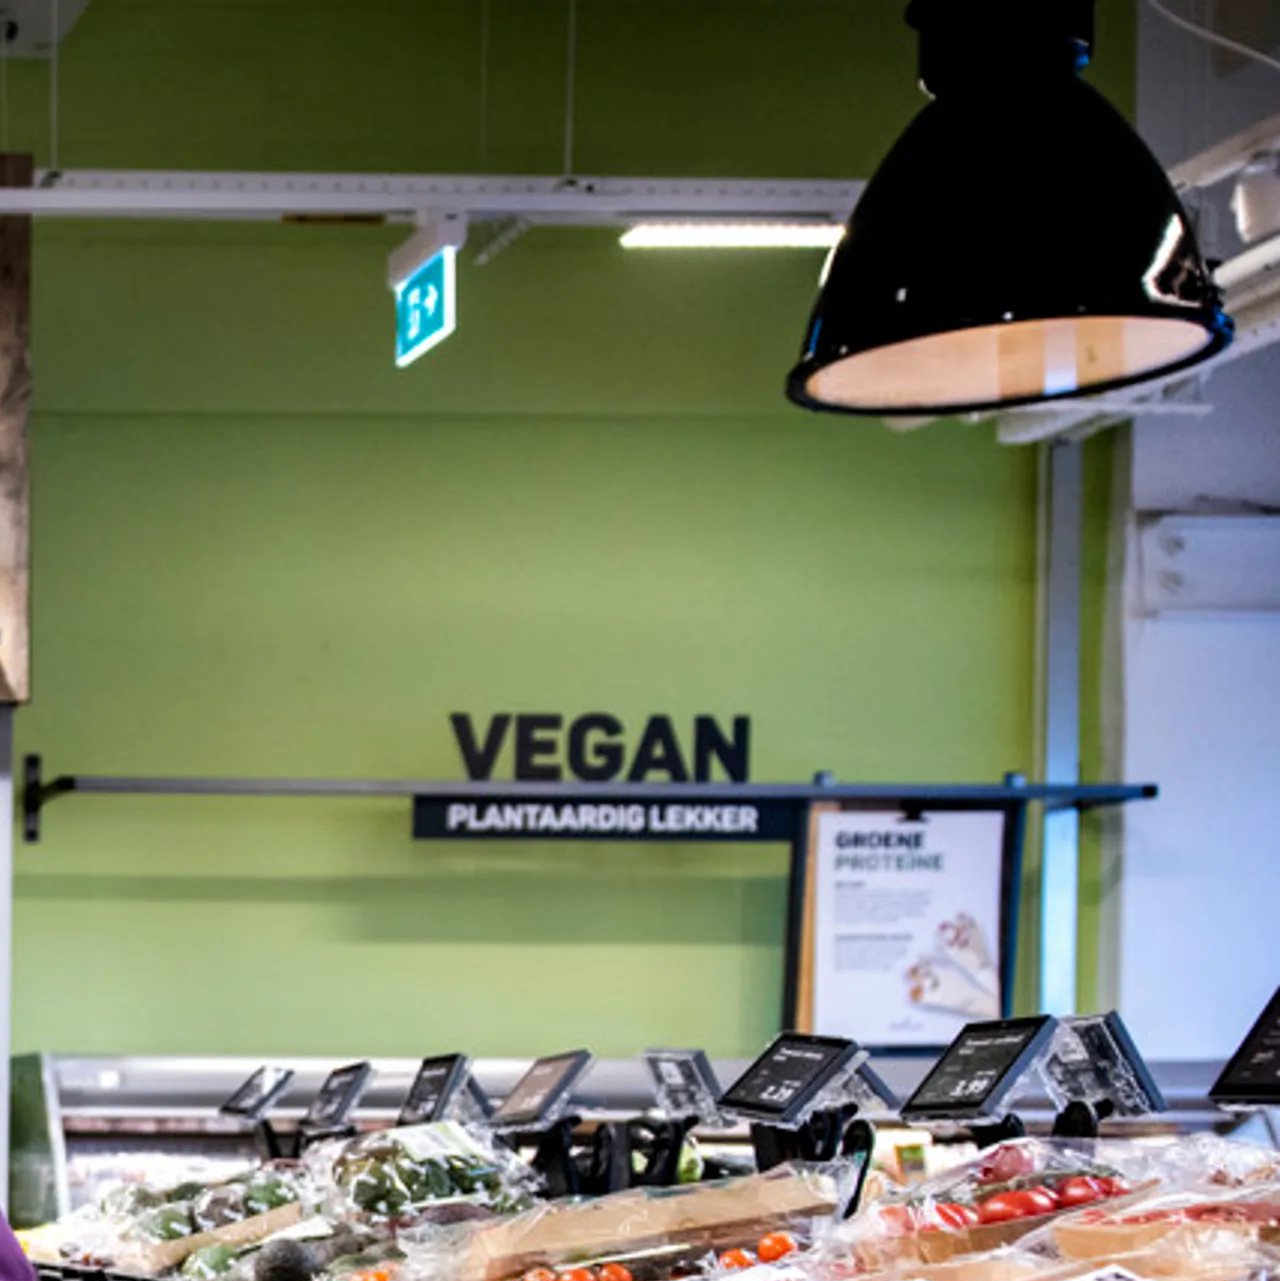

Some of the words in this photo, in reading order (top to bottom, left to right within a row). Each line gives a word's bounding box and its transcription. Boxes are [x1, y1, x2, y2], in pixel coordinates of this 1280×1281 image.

[450, 712, 750, 783] VEGAN
[446, 803, 645, 831] PLANTAARDIG
[649, 805, 758, 832] LEKKER
[835, 831, 926, 850] GROENE
